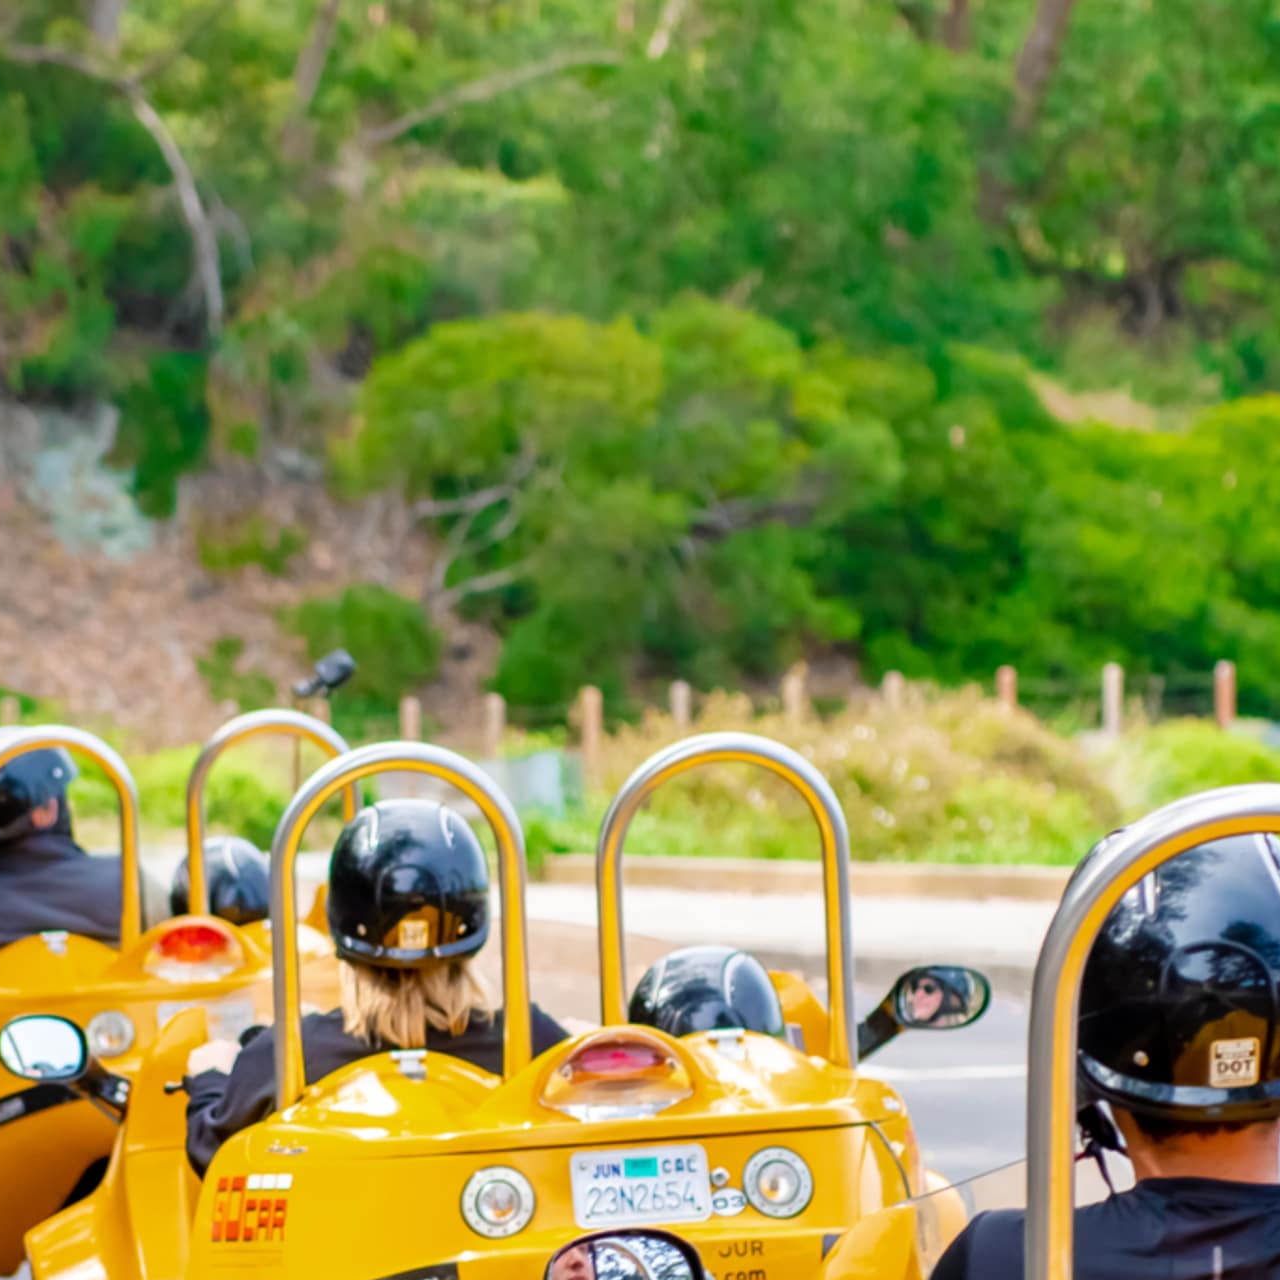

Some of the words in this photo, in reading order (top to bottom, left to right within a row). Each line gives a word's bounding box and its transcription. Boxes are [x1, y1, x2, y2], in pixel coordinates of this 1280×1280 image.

[1217, 1060, 1252, 1075] DOT
[593, 1164, 621, 1179] JUN
[662, 1157, 697, 1173] CAL
[587, 1180, 695, 1216] 23N2654
[712, 1194, 745, 1211] 03
